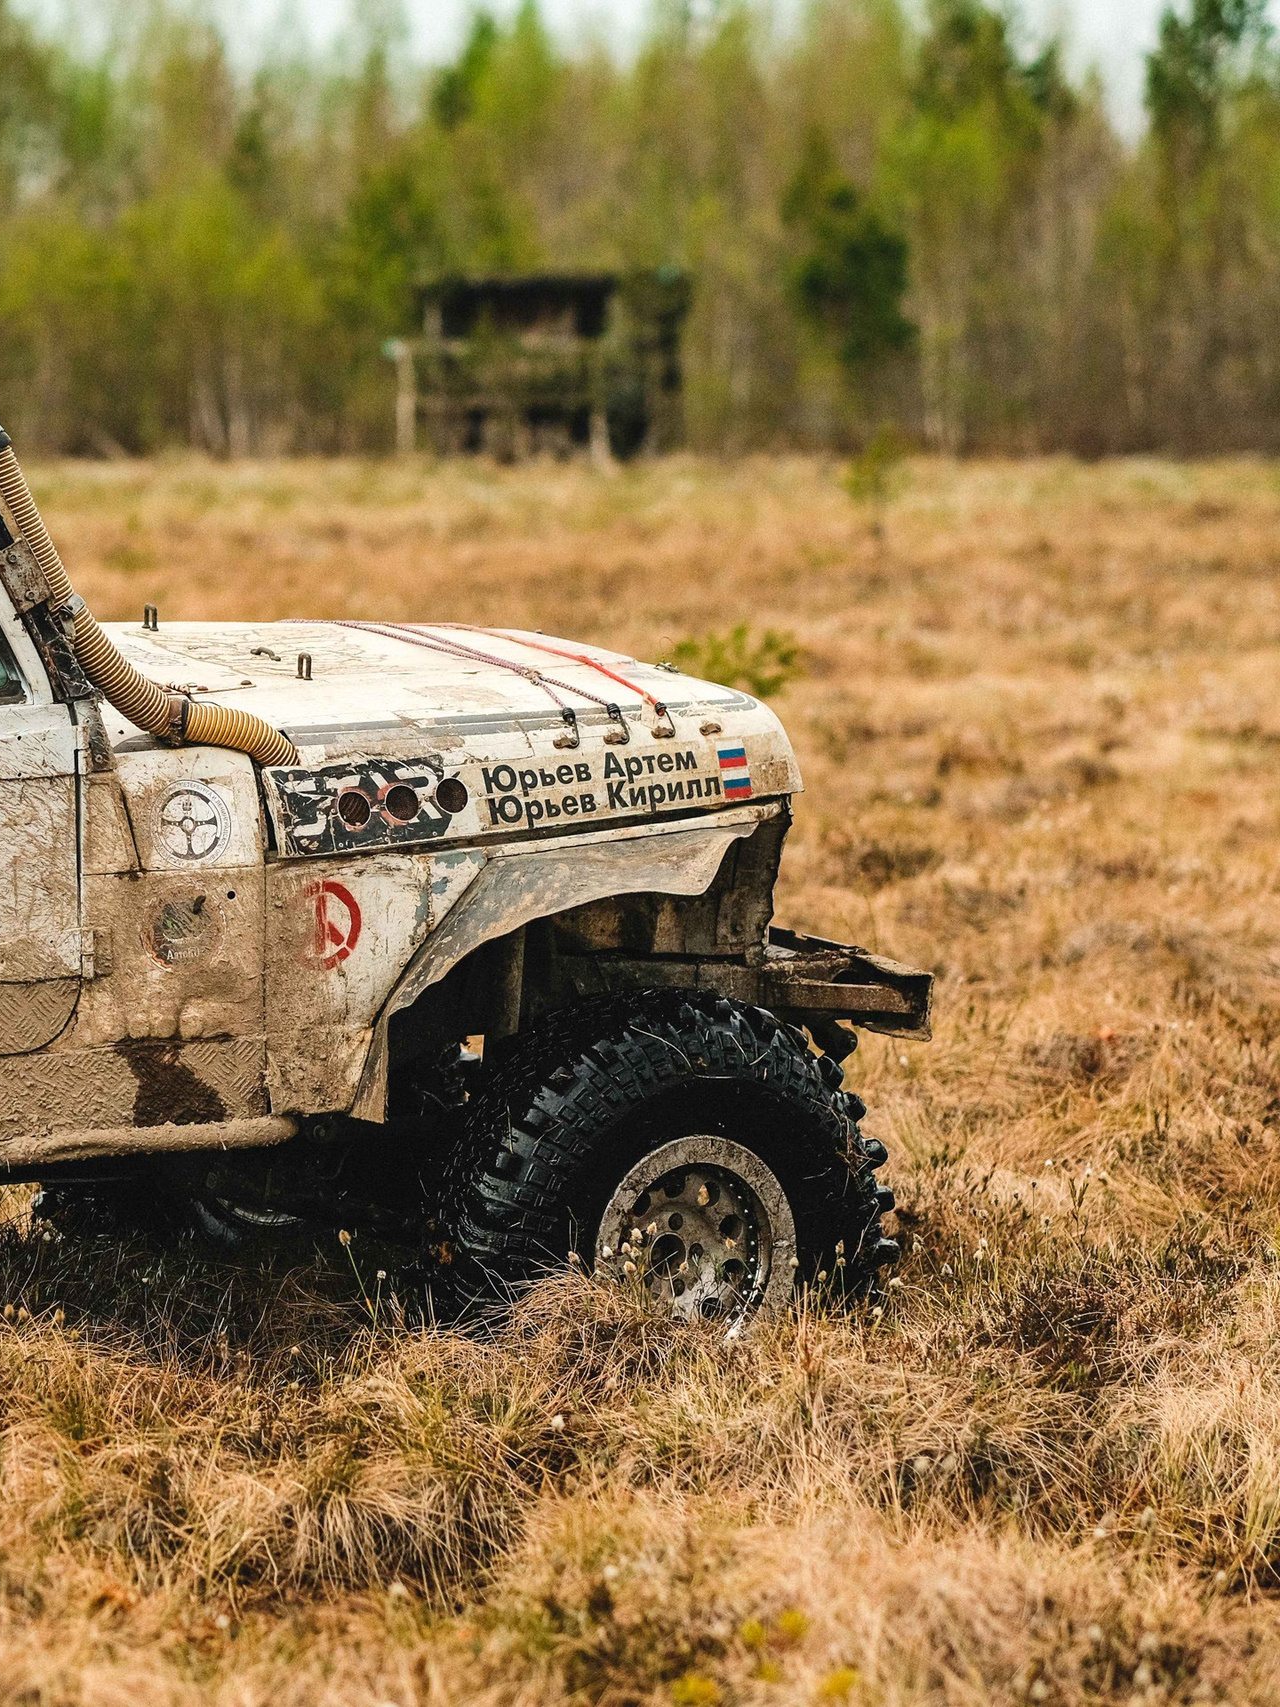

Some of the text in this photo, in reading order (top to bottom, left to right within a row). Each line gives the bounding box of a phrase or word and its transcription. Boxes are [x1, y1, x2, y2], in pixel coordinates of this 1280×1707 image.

[481, 751, 698, 797] Юрьев Артем
[486, 790, 598, 828] Юрьев
[606, 776, 721, 814] Кирилл
